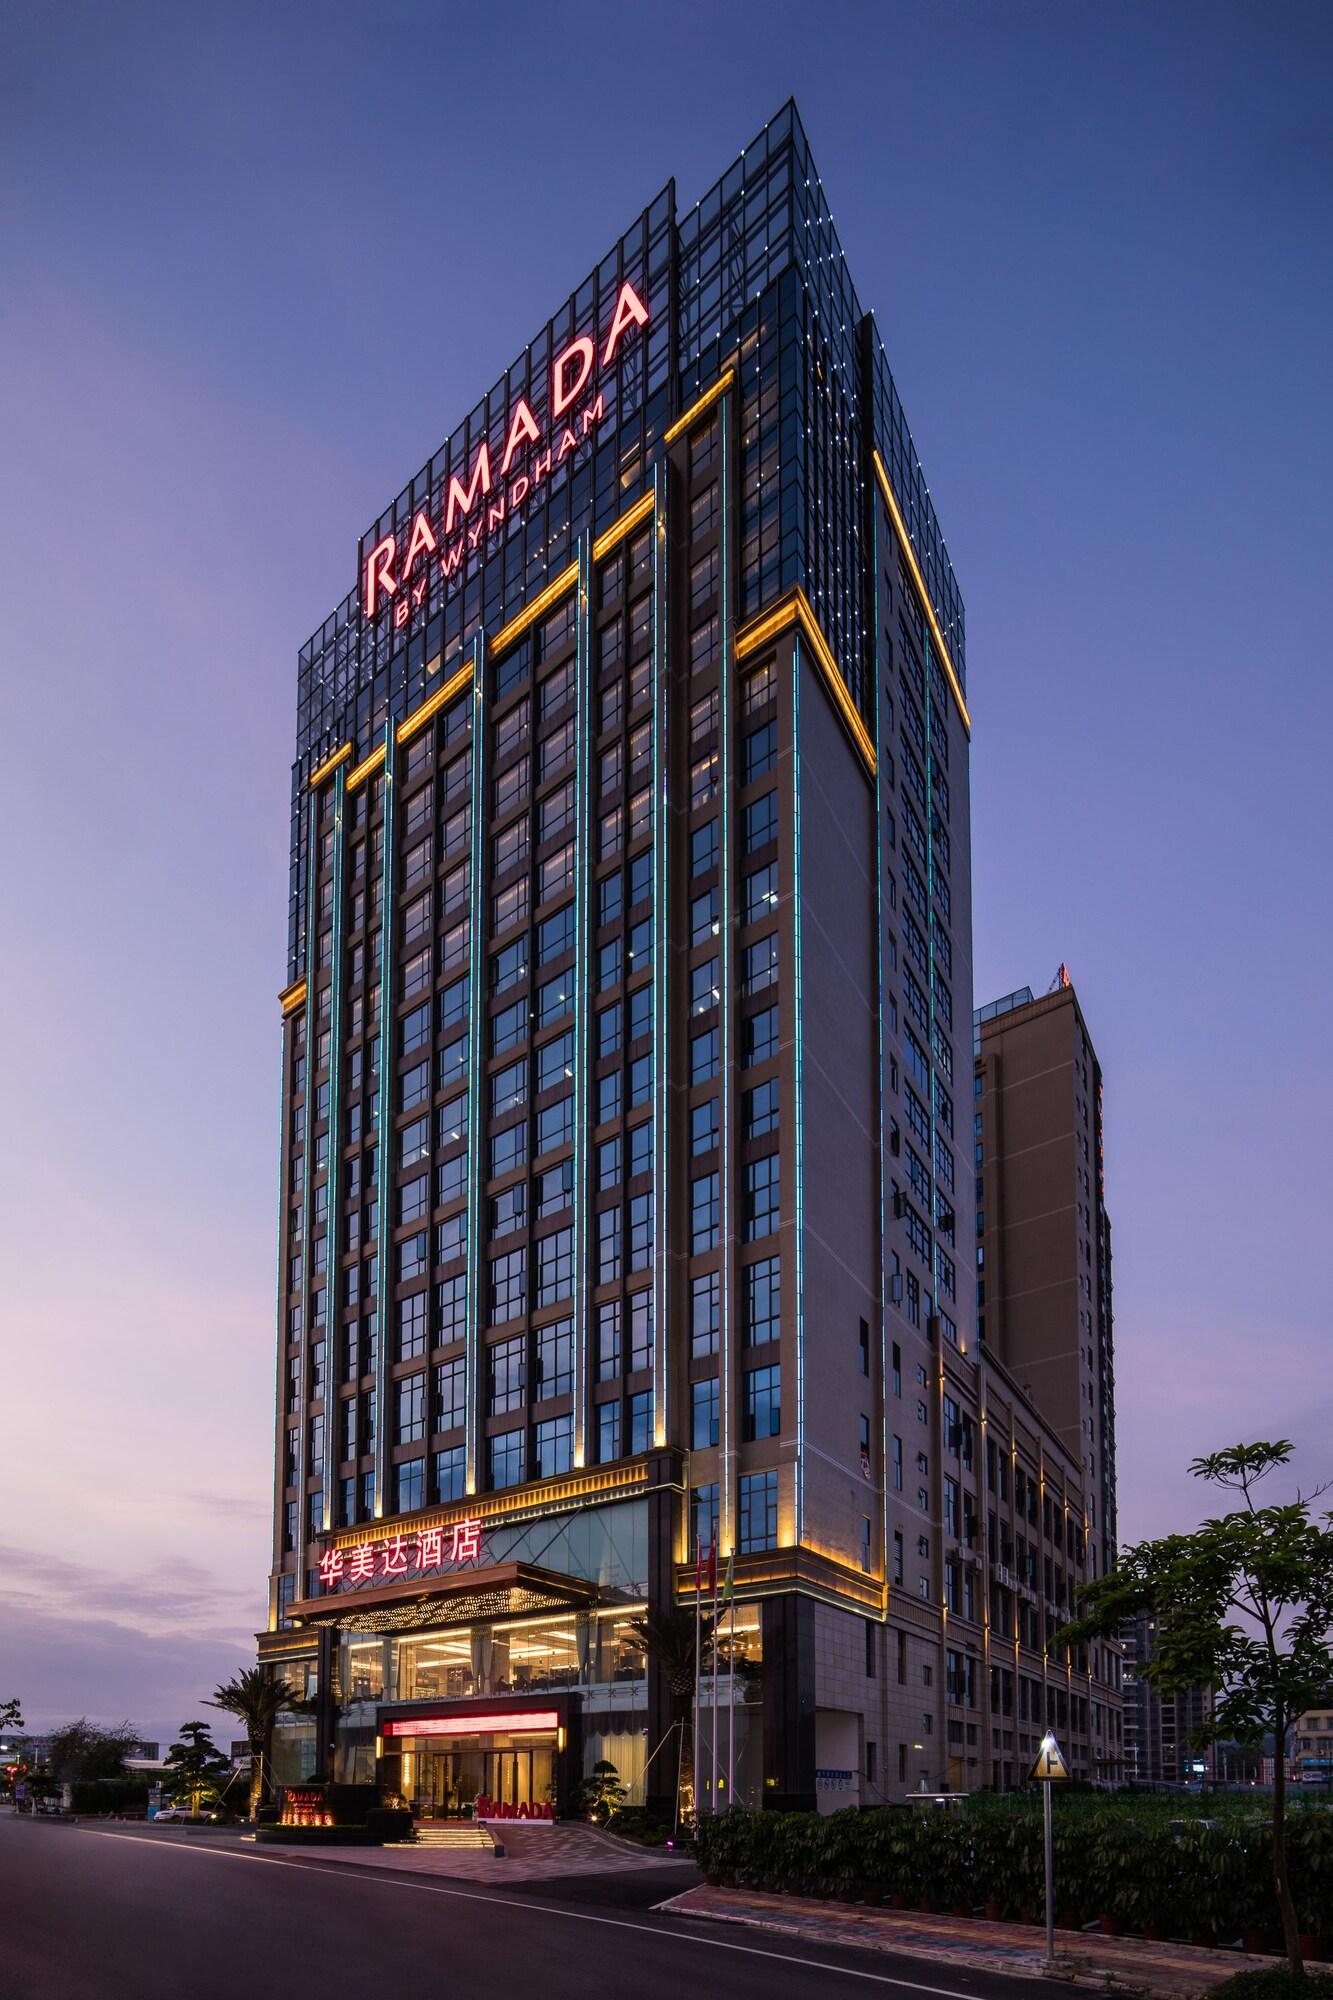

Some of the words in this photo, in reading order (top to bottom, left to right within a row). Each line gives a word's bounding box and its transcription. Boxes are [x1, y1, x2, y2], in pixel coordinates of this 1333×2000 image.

[367, 282, 649, 619] RAMADA
[395, 577, 427, 629] BY
[440, 394, 604, 577] WYNDHAM
[318, 1517, 482, 1587] 华美达酒店
[477, 1795, 555, 1819] RAMADA
